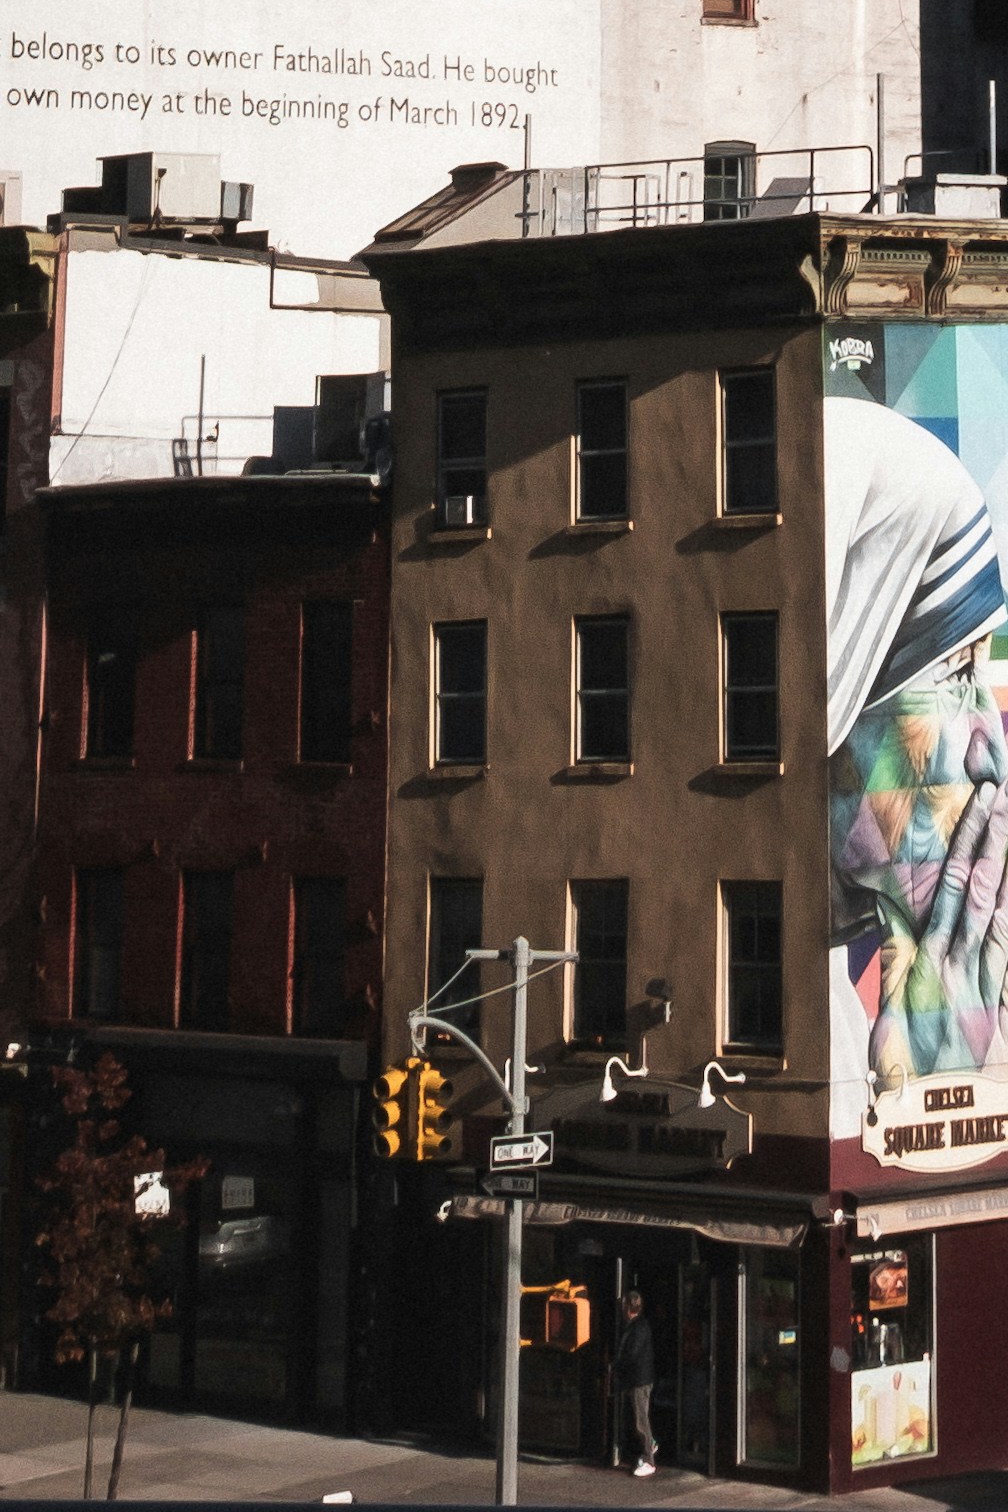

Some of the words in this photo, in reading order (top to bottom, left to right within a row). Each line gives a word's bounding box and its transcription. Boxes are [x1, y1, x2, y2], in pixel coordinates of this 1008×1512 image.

[11, 31, 105, 71] belongs
[115, 42, 141, 64] to
[150, 39, 177, 66] its
[186, 49, 264, 70] owner
[273, 44, 372, 77] Fathallah
[381, 50, 437, 80] Saad.
[443, 54, 475, 82] He
[484, 57, 559, 94] bought
[6, 87, 59, 109] own
[70, 90, 153, 121] money
[162, 92, 185, 114] at
[194, 87, 232, 116] the
[241, 89, 349, 129] beginning
[358, 96, 383, 122] of
[390, 96, 458, 126] March
[828, 337, 875, 361] KOBRA
[924, 1085, 975, 1112] CHELSEA
[497, 1146, 513, 1160] ONE
[522, 1144, 540, 1156] WAY
[884, 1121, 945, 1158] SQUARE
